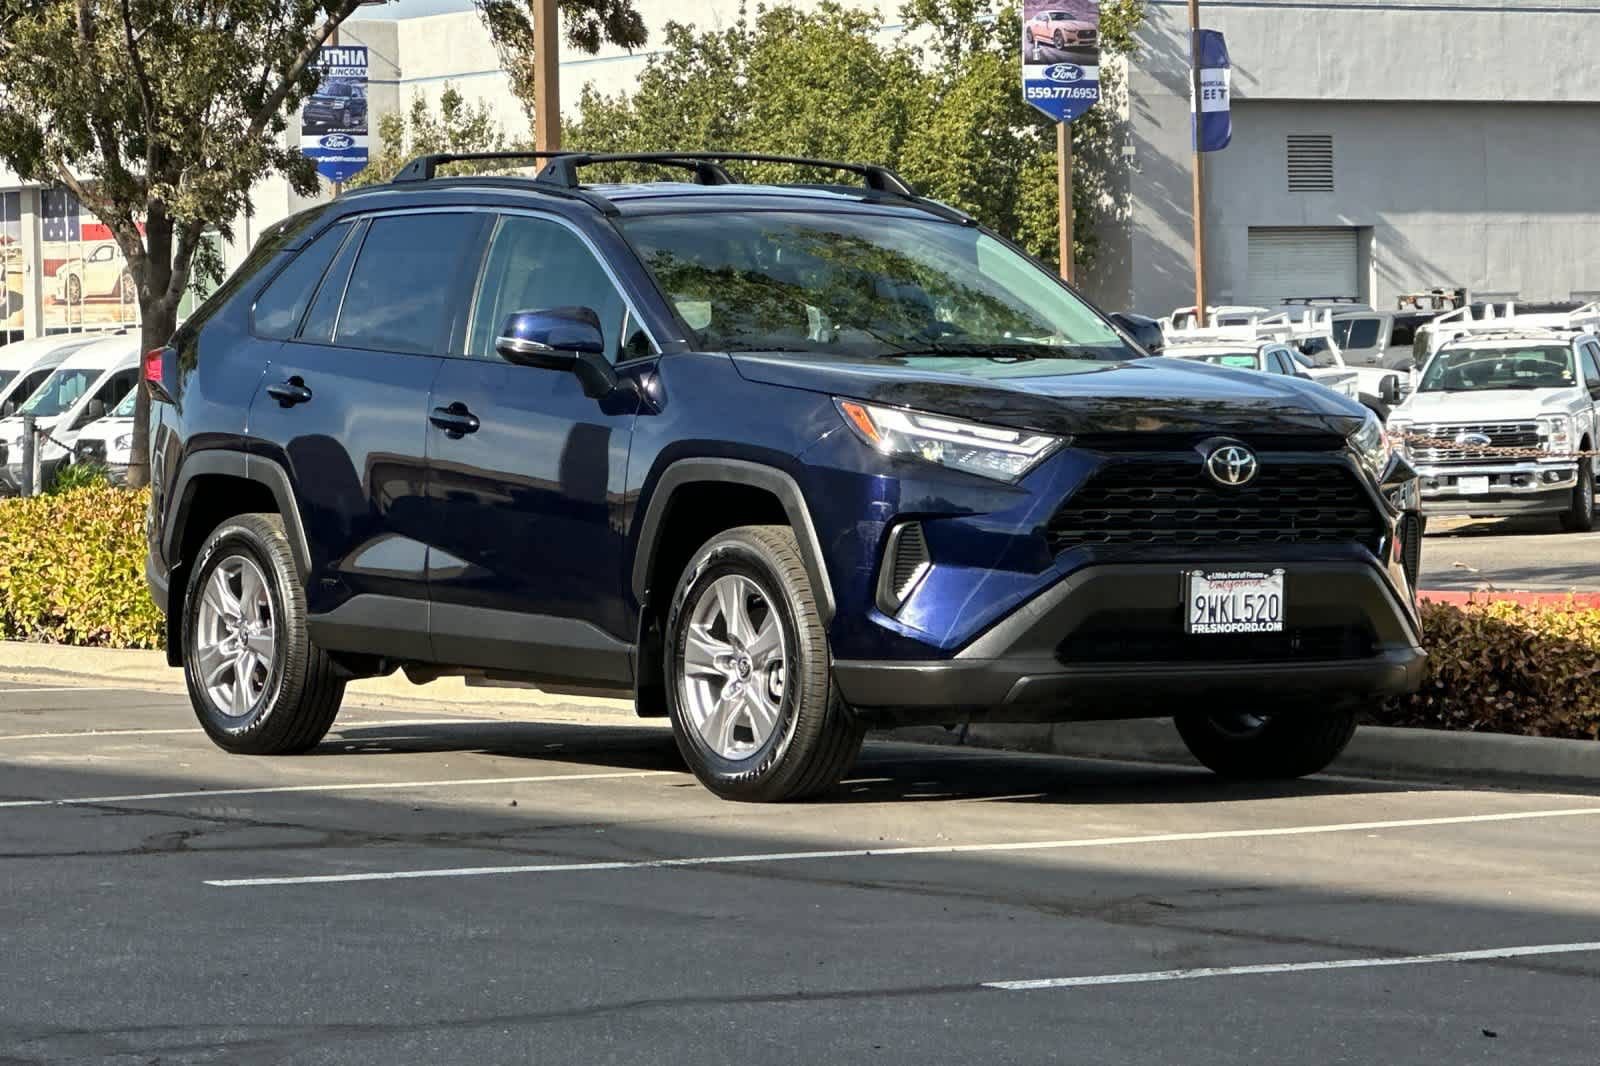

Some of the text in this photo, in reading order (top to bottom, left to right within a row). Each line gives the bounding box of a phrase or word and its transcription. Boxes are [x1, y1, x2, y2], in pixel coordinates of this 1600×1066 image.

[330, 67, 366, 76] LINCOLN
[1051, 65, 1078, 79] Ford
[1027, 87, 1097, 99] 559.777.6952
[1203, 88, 1228, 100] EET
[326, 134, 350, 148] Ford
[1195, 594, 1279, 623] 9WKL520
[1191, 622, 1283, 634] FRESNOFORD.COM
